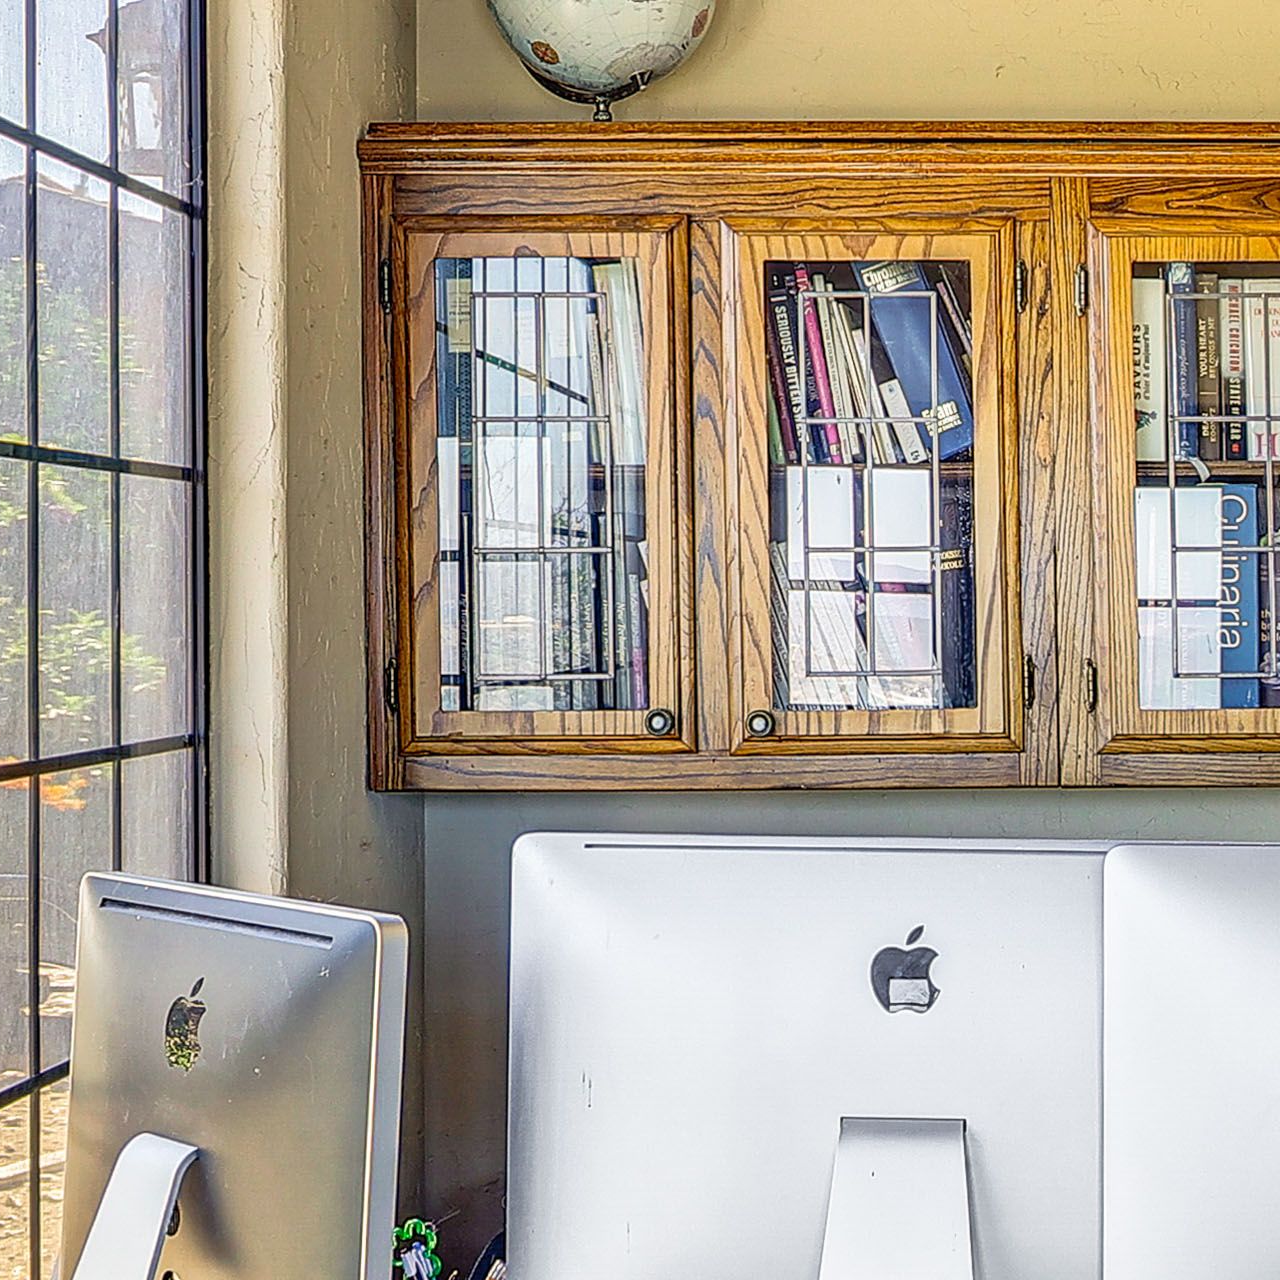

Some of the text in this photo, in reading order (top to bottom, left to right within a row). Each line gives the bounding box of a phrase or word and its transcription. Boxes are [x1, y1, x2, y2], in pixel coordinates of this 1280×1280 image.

[796, 276, 813, 316] TAAS
[1199, 318, 1208, 377] YOUR HEART
[1228, 285, 1241, 372] MCHAEL CRICHTON
[773, 306, 794, 365] SERIOUSLY
[785, 366, 799, 405] BITTER
[1132, 323, 1141, 400] SAVEURS
[1207, 339, 1217, 378] BELONGS
[1229, 377, 1242, 406] STATE
[1209, 407, 1217, 443] KOOTZ
[1229, 421, 1242, 441] EAR
[1215, 494, 1249, 650] Cuinaria
